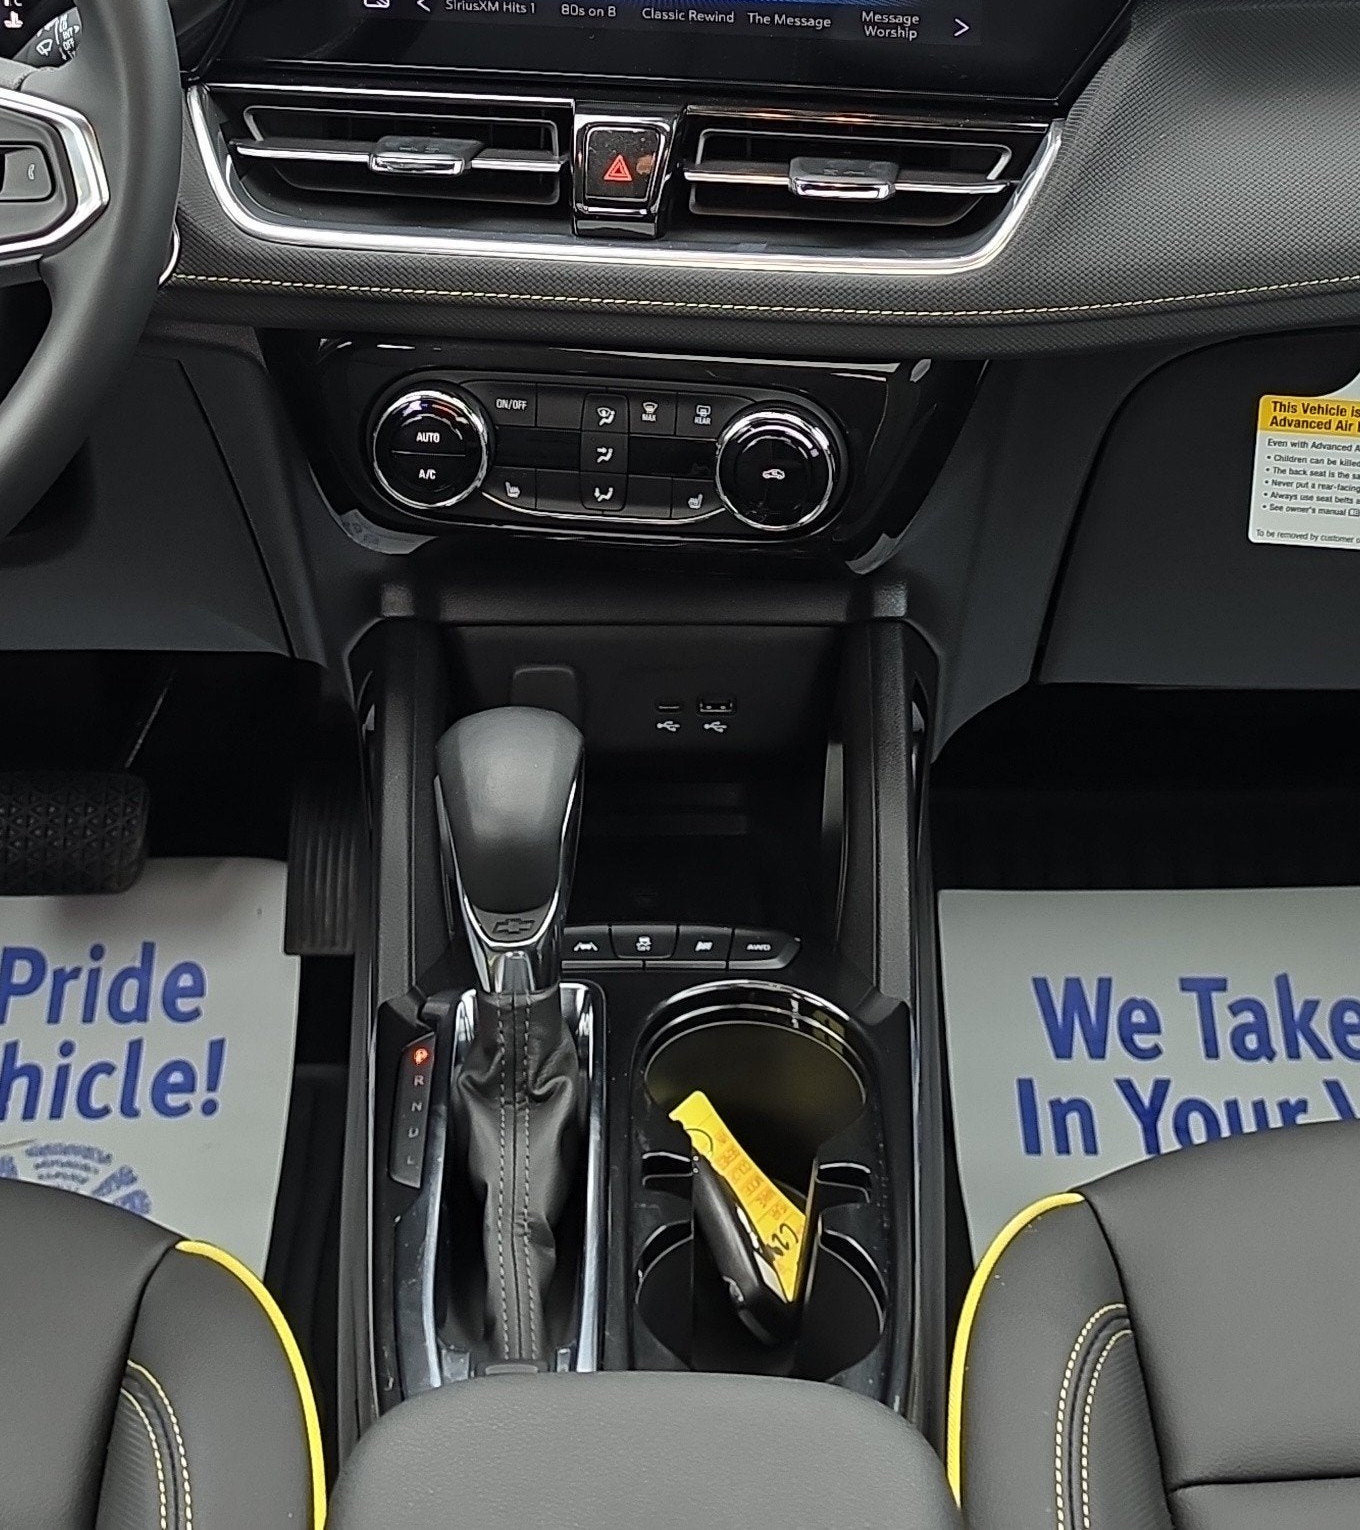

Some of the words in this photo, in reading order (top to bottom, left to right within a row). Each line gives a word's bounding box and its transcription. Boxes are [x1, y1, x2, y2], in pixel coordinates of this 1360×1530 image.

[503, 1, 527, 14] Hits
[561, 4, 585, 17] 80s
[588, 7, 605, 17] on
[641, 7, 686, 22] Classic
[688, 9, 735, 24] Rewind
[747, 11, 772, 25] The
[774, 14, 832, 30] Message
[861, 11, 920, 26] Message
[863, 25, 918, 42] Worship
[496, 398, 528, 411] ON/OFF
[1271, 400, 1298, 414] This
[1300, 402, 1347, 417] Vehicle
[1269, 415, 1332, 430] Advanced
[1334, 419, 1354, 432] Air
[416, 432, 440, 444] AUTO
[1267, 438, 1288, 448] Even
[1290, 439, 1309, 449] with
[1310, 441, 1353, 452] Advanced
[1273, 454, 1308, 464] Children
[1309, 457, 1325, 465] can
[1327, 458, 1337, 466] be
[418, 468, 437, 480] A/C
[1272, 466, 1287, 475] The
[1288, 467, 1308, 476] back
[1309, 469, 1327, 478] seat
[1337, 471, 1350, 480] the
[1271, 478, 1294, 488] Never
[1295, 481, 1309, 489] put
[1270, 491, 1298, 502] Always
[1315, 495, 1333, 503] seat
[1268, 503, 1284, 511] See
[1317, 507, 1346, 516] manual
[1256, 528, 1265, 537] To
[1266, 529, 1275, 538] be
[1276, 531, 1309, 541] removed
[1309, 533, 1319, 543] by
[1320, 533, 1355, 544] customer
[746, 943, 772, 952] AWD
[1032, 975, 1164, 1062] We
[414, 1048, 429, 1065] P
[413, 1075, 424, 1086] R
[411, 1101, 422, 1112] N
[1016, 1077, 1098, 1156] In
[1114, 1077, 1310, 1156] Your
